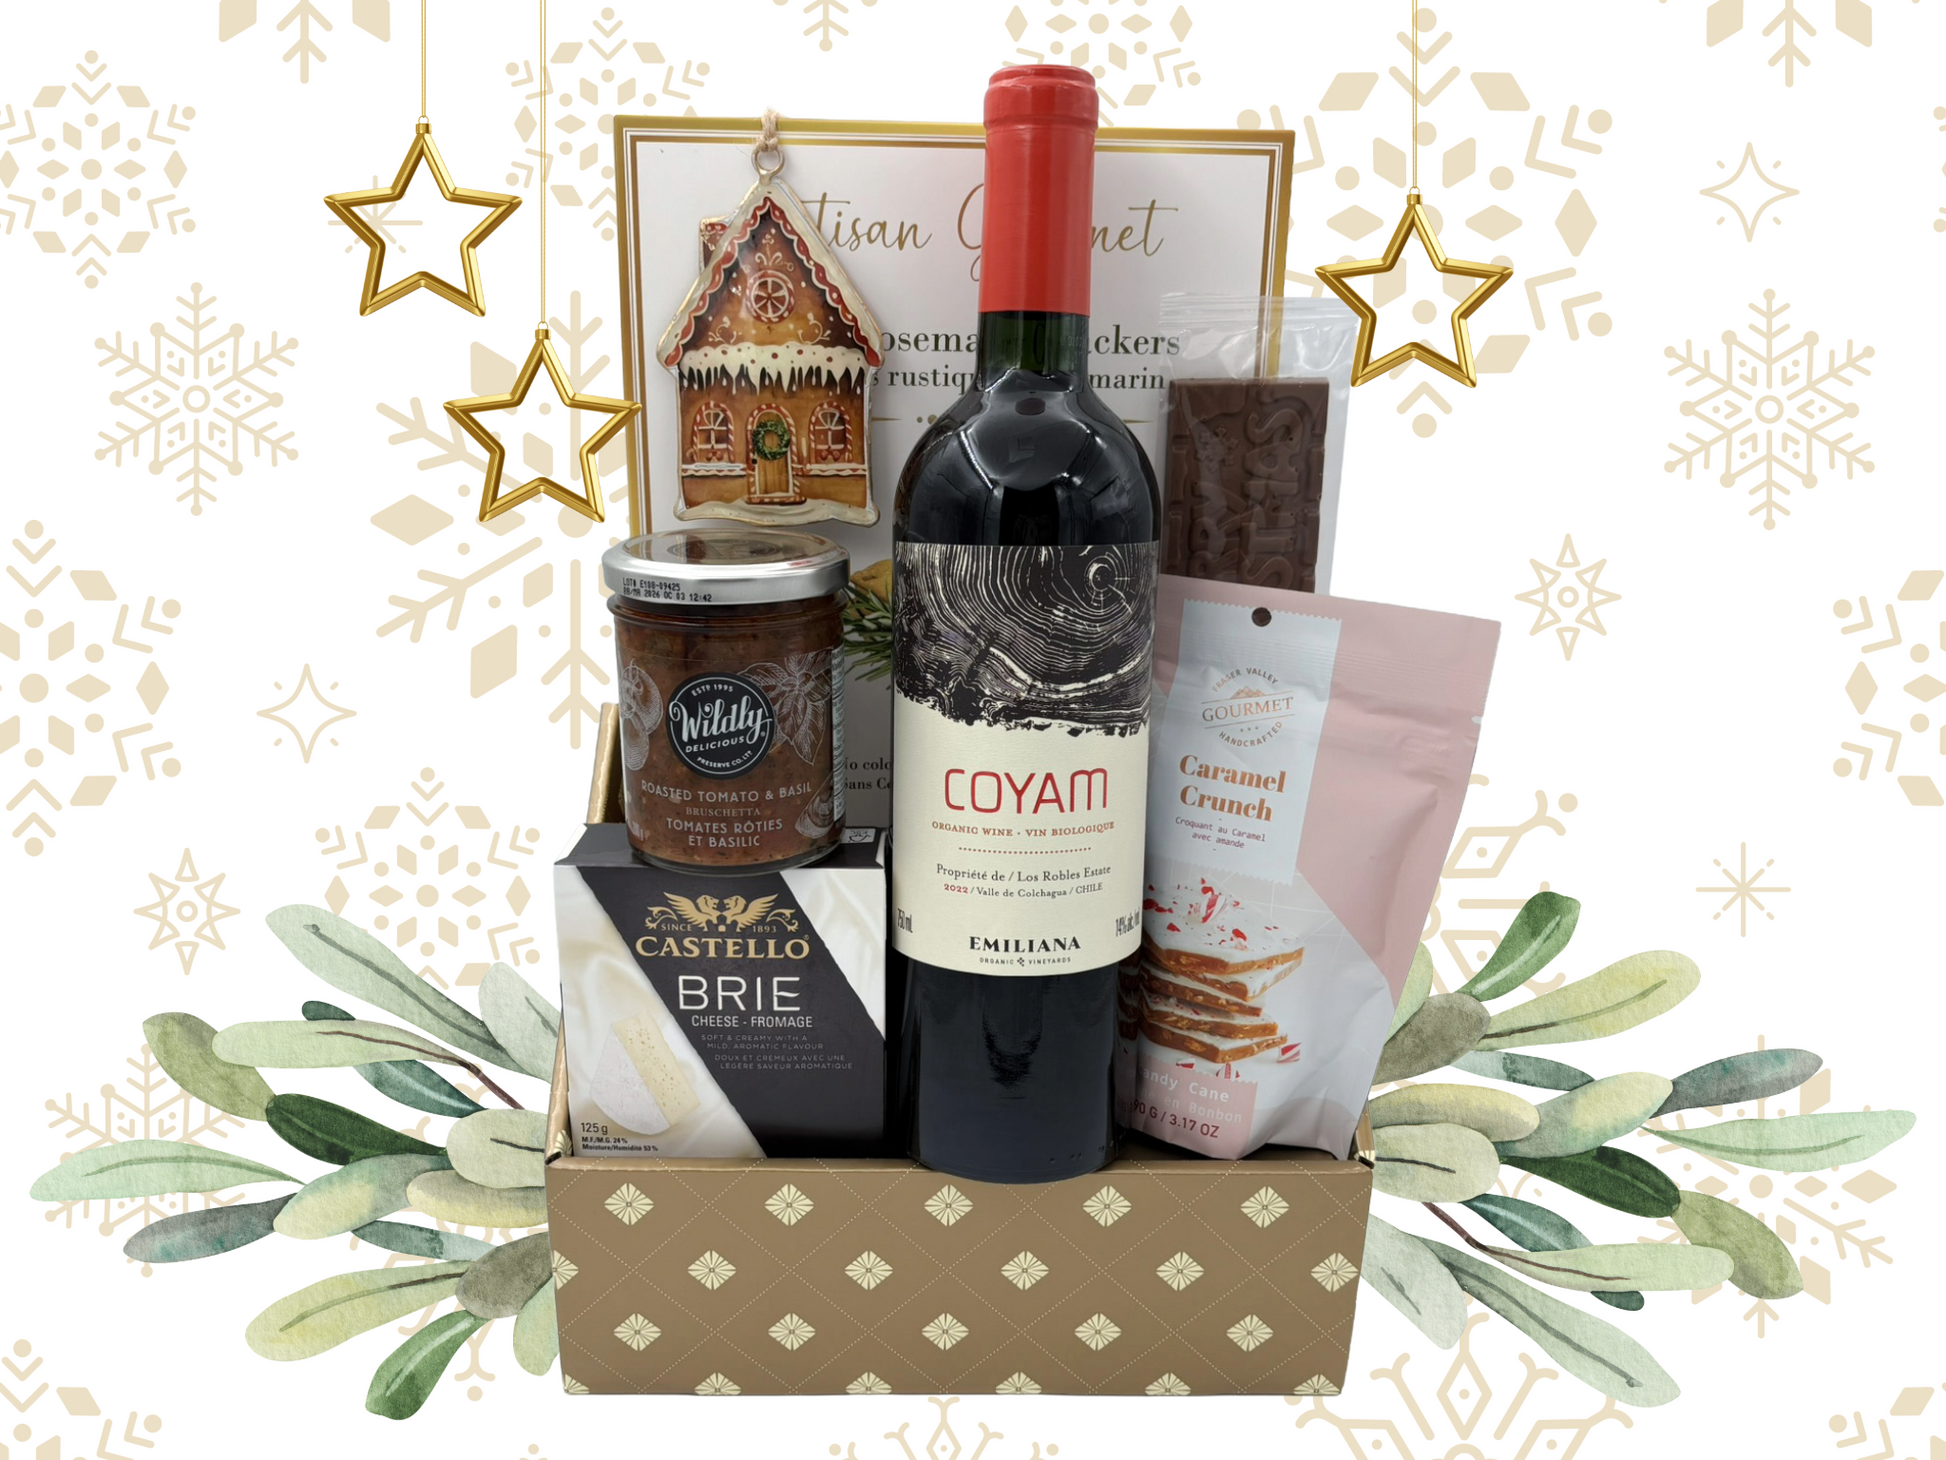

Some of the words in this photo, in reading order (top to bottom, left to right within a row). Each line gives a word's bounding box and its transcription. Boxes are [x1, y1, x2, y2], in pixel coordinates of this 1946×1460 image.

[802, 191, 932, 253] tisan
[882, 331, 979, 353] osema
[1089, 324, 1180, 355] ckers
[888, 364, 975, 396] rustiq
[1089, 366, 1166, 390] marin
[644, 589, 660, 599] 2026
[664, 591, 672, 600] OC
[676, 592, 685, 601] 03
[689, 593, 713, 602] 12:42
[713, 683, 734, 693] 1995
[1211, 668, 1242, 693] FRASER
[1245, 667, 1279, 685] VALLEY
[668, 695, 773, 744] Wildly
[1201, 696, 1294, 723] GOURMET
[685, 735, 745, 753] DELICIOUS
[1218, 720, 1283, 748] HANDCRAFTED
[696, 756, 731, 768] PRESERVE
[1179, 754, 1287, 794] Caramel
[641, 779, 692, 802] ROASTED
[697, 789, 759, 803] TOMATO
[765, 789, 775, 801] &
[778, 781, 812, 800] BASIL
[944, 767, 1108, 815] COYAM
[685, 805, 761, 817] BRUSCHETTA
[1179, 785, 1273, 823] Crunch
[666, 818, 728, 834] TOMATES
[733, 817, 783, 834] RÔTIES
[931, 820, 978, 835] ORGANIC
[982, 828, 1013, 837] WINE
[1025, 829, 1047, 837] VIN
[1051, 821, 1115, 837] BIOLOGIQUE
[1175, 816, 1214, 833] Croquant
[1217, 826, 1228, 834] au
[1232, 828, 1266, 842] Caramel
[688, 835, 704, 847] ET
[708, 835, 760, 848] BASILIC
[1191, 832, 1212, 843] avec
[1215, 837, 1245, 849] amande
[936, 863, 988, 882] Propriété
[991, 871, 1006, 882] de
[1017, 871, 1039, 882] Los
[1043, 870, 1081, 882] Robles
[1083, 865, 1112, 878] Estate
[943, 883, 969, 894] 2022
[976, 886, 1000, 897] Valle
[1002, 888, 1015, 898] de
[1017, 888, 1067, 899] Colchagua
[1075, 882, 1103, 894] CHILE
[661, 923, 692, 932] SINCE
[752, 924, 777, 933] 1893
[635, 936, 810, 960] CASTELLO
[969, 936, 1081, 953] EMILIANA
[979, 957, 1014, 966] ORGANIC
[1028, 956, 1072, 966] VINEYARDS
[677, 975, 800, 1011] BRIE
[691, 1015, 739, 1028] CHEESE
[751, 1016, 813, 1028] FROMAGE
[795, 1062, 853, 1070] AROMATIQUE
[1141, 1068, 1179, 1091] andy
[1188, 1082, 1230, 1103] Cane
[1149, 1106, 1158, 1119] G
[1169, 1113, 1198, 1131] 3.17
[1200, 1123, 1220, 1139] OZ
[1189, 1102, 1242, 1123] Bonbon
[581, 1122, 599, 1133] 125
[601, 1125, 608, 1135] g
